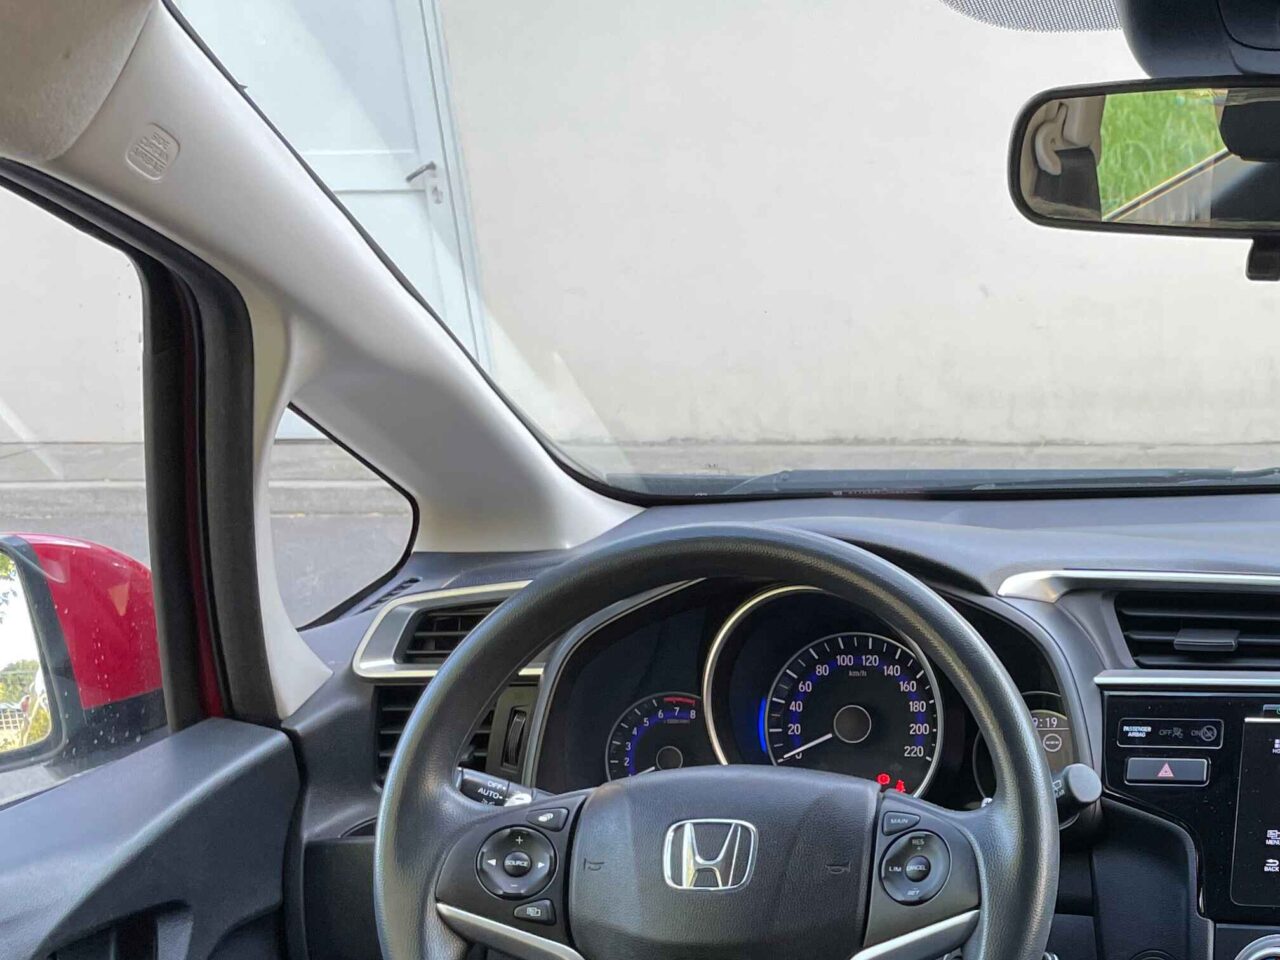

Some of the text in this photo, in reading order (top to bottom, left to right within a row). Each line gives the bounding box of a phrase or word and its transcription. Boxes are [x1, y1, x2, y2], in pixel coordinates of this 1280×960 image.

[836, 655, 854, 667] 100
[862, 655, 880, 667] 120
[816, 665, 829, 676] 80
[884, 665, 901, 676] 140
[798, 681, 812, 692] 60
[900, 681, 917, 692] 160
[673, 706, 680, 717] 7
[789, 701, 803, 712] 40
[909, 701, 926, 712] 180
[657, 709, 664, 719] 6
[689, 709, 697, 719] 8
[643, 717, 649, 727] 5
[631, 727, 638, 736] 4
[788, 723, 801, 735] 20
[909, 723, 930, 735] 200
[625, 742, 632, 751] 3
[904, 746, 924, 757] 220
[624, 757, 630, 767] 2
[487, 780, 501, 790] OFF
[477, 787, 500, 799] AUTO
